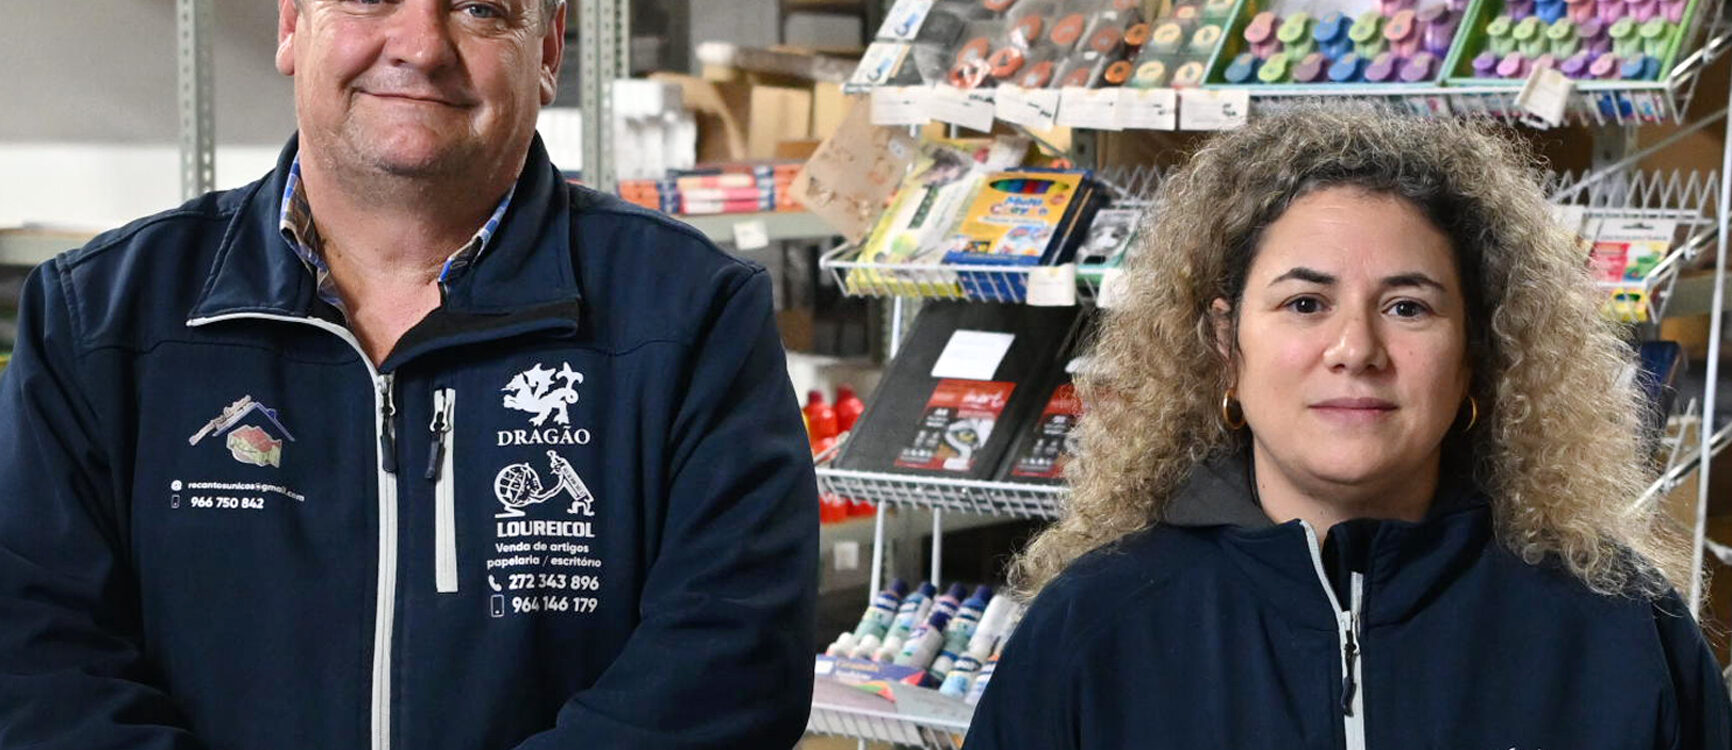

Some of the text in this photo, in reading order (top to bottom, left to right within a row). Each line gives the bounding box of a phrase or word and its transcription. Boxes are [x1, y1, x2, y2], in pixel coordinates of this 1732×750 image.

[497, 425, 591, 447] DRAGÃO
[188, 481, 305, 503] recantosunicos@gmail.com
[190, 496, 265, 510] 966 750 842
[497, 521, 595, 538] LOUREICOL
[495, 541, 590, 554] Venda de artigos
[486, 555, 540, 570] papelaria
[550, 556, 602, 568] escritório
[508, 574, 600, 591] 272 343 896
[512, 596, 598, 613] 964 146 179
